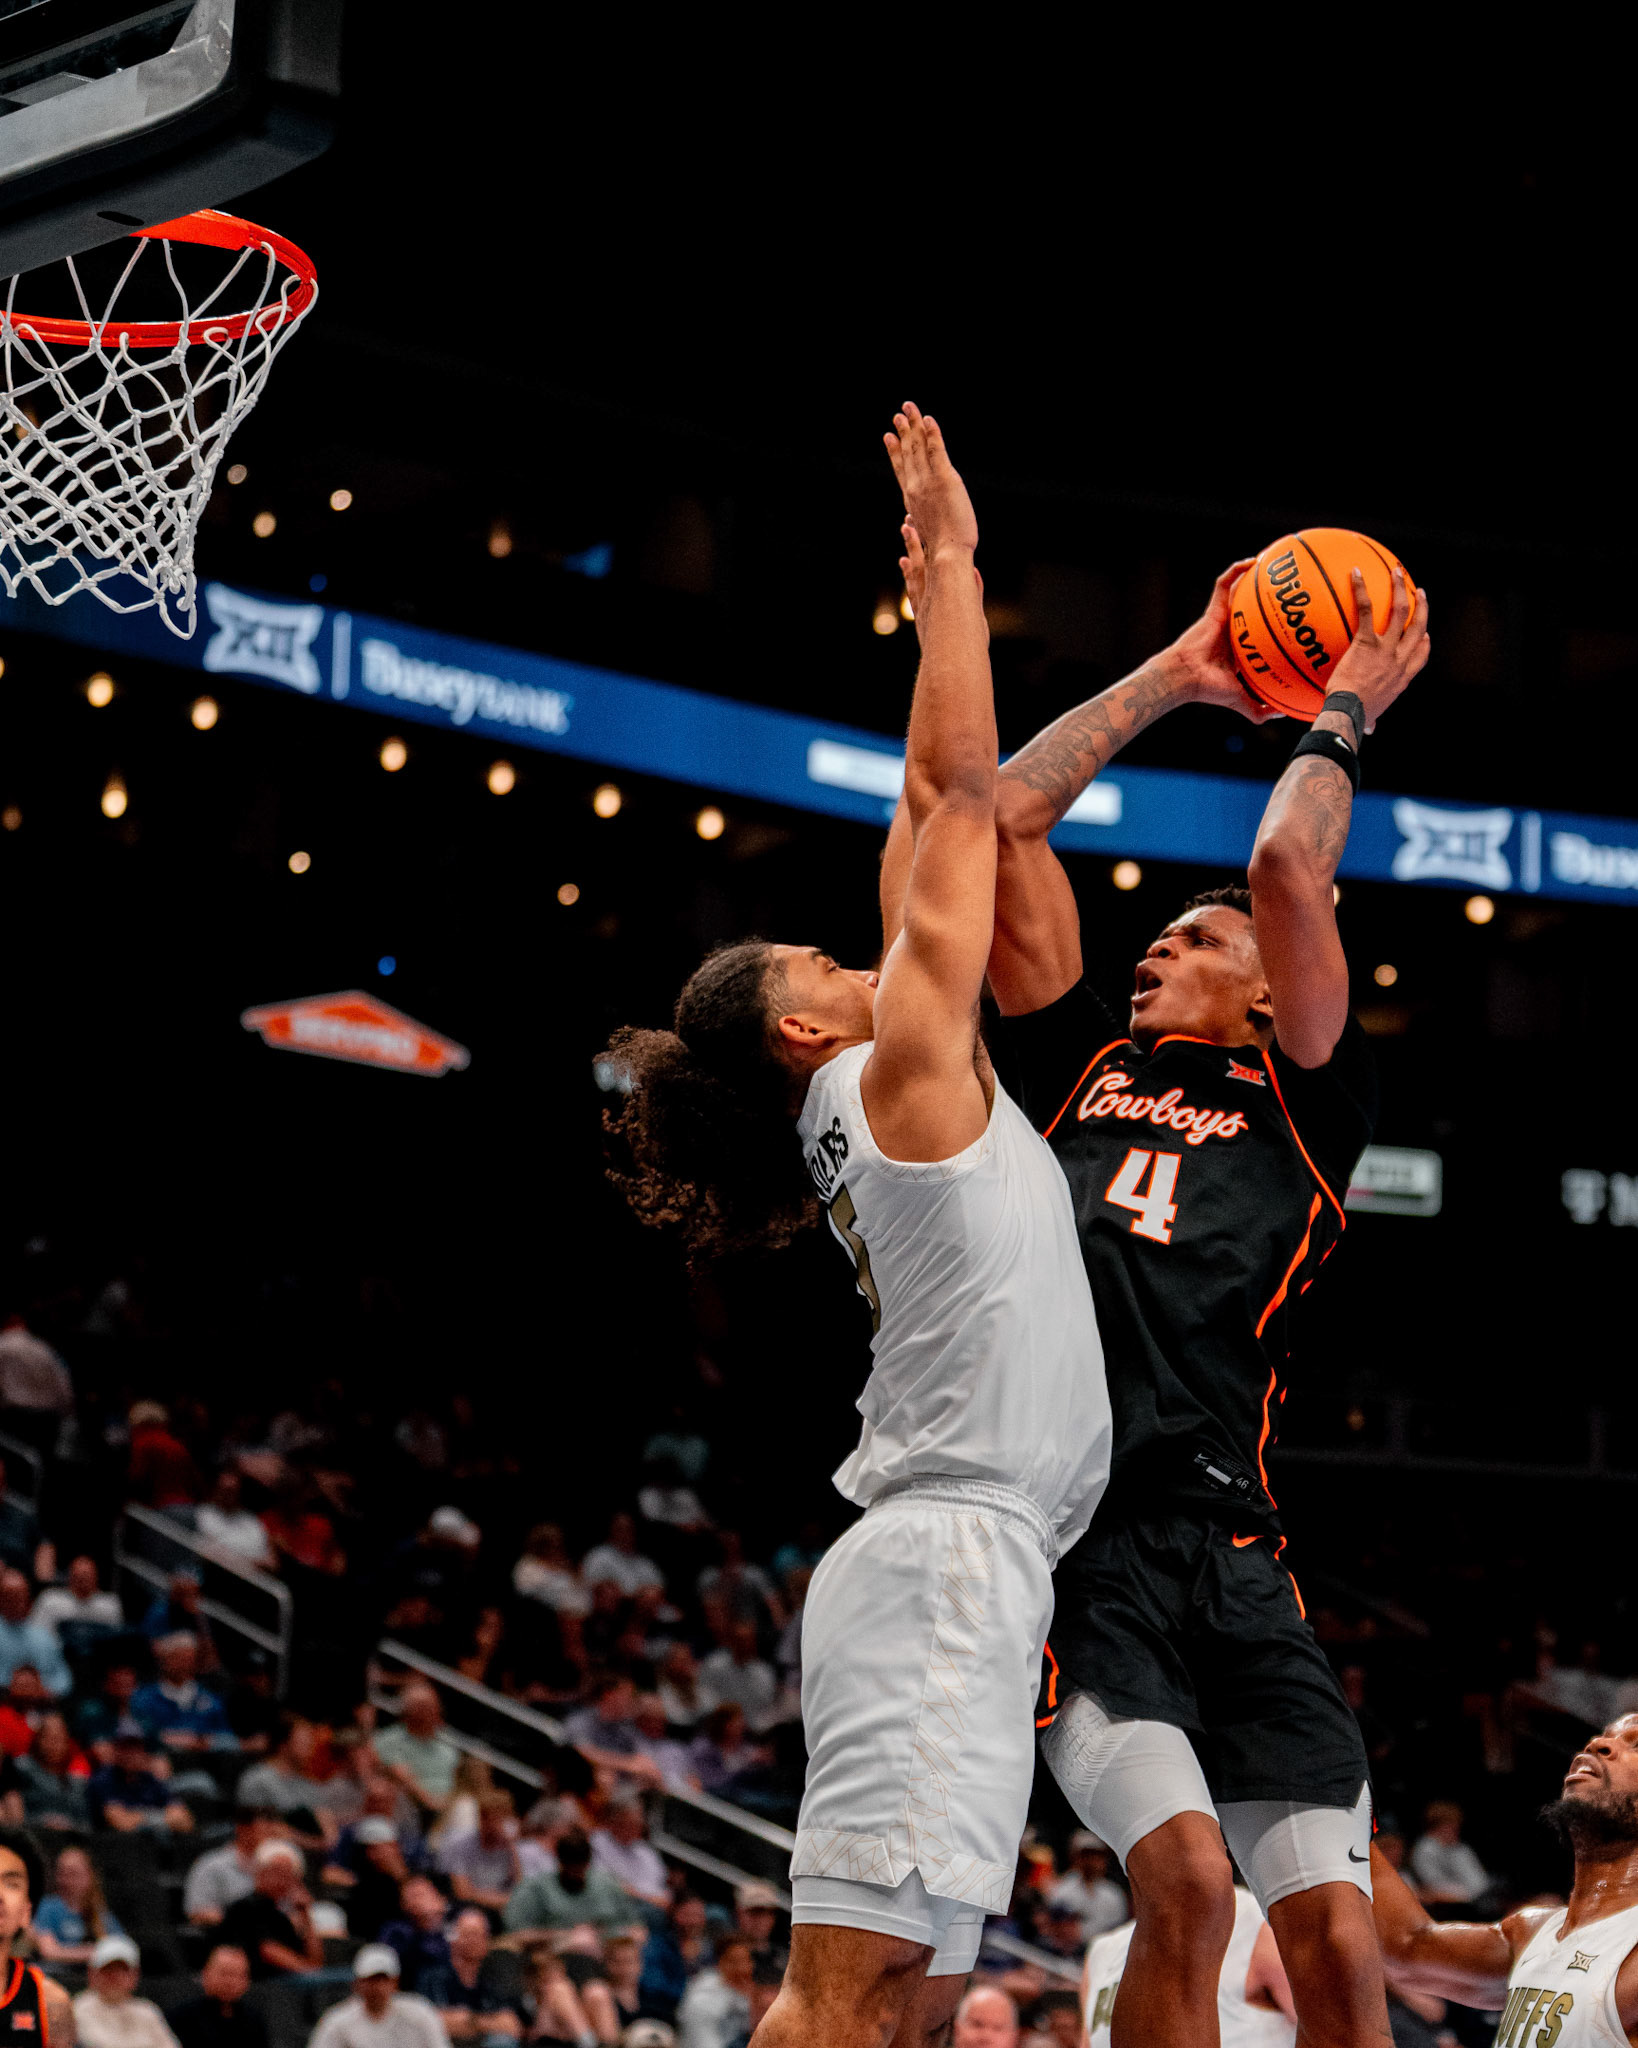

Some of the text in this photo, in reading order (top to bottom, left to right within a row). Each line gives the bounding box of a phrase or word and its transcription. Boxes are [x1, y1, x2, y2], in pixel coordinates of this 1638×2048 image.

[1233, 610, 1271, 674] EVO
[1267, 550, 1330, 671] Wilson
[1077, 1071, 1249, 1146] Cowboys
[1104, 1147, 1182, 1245] 4
